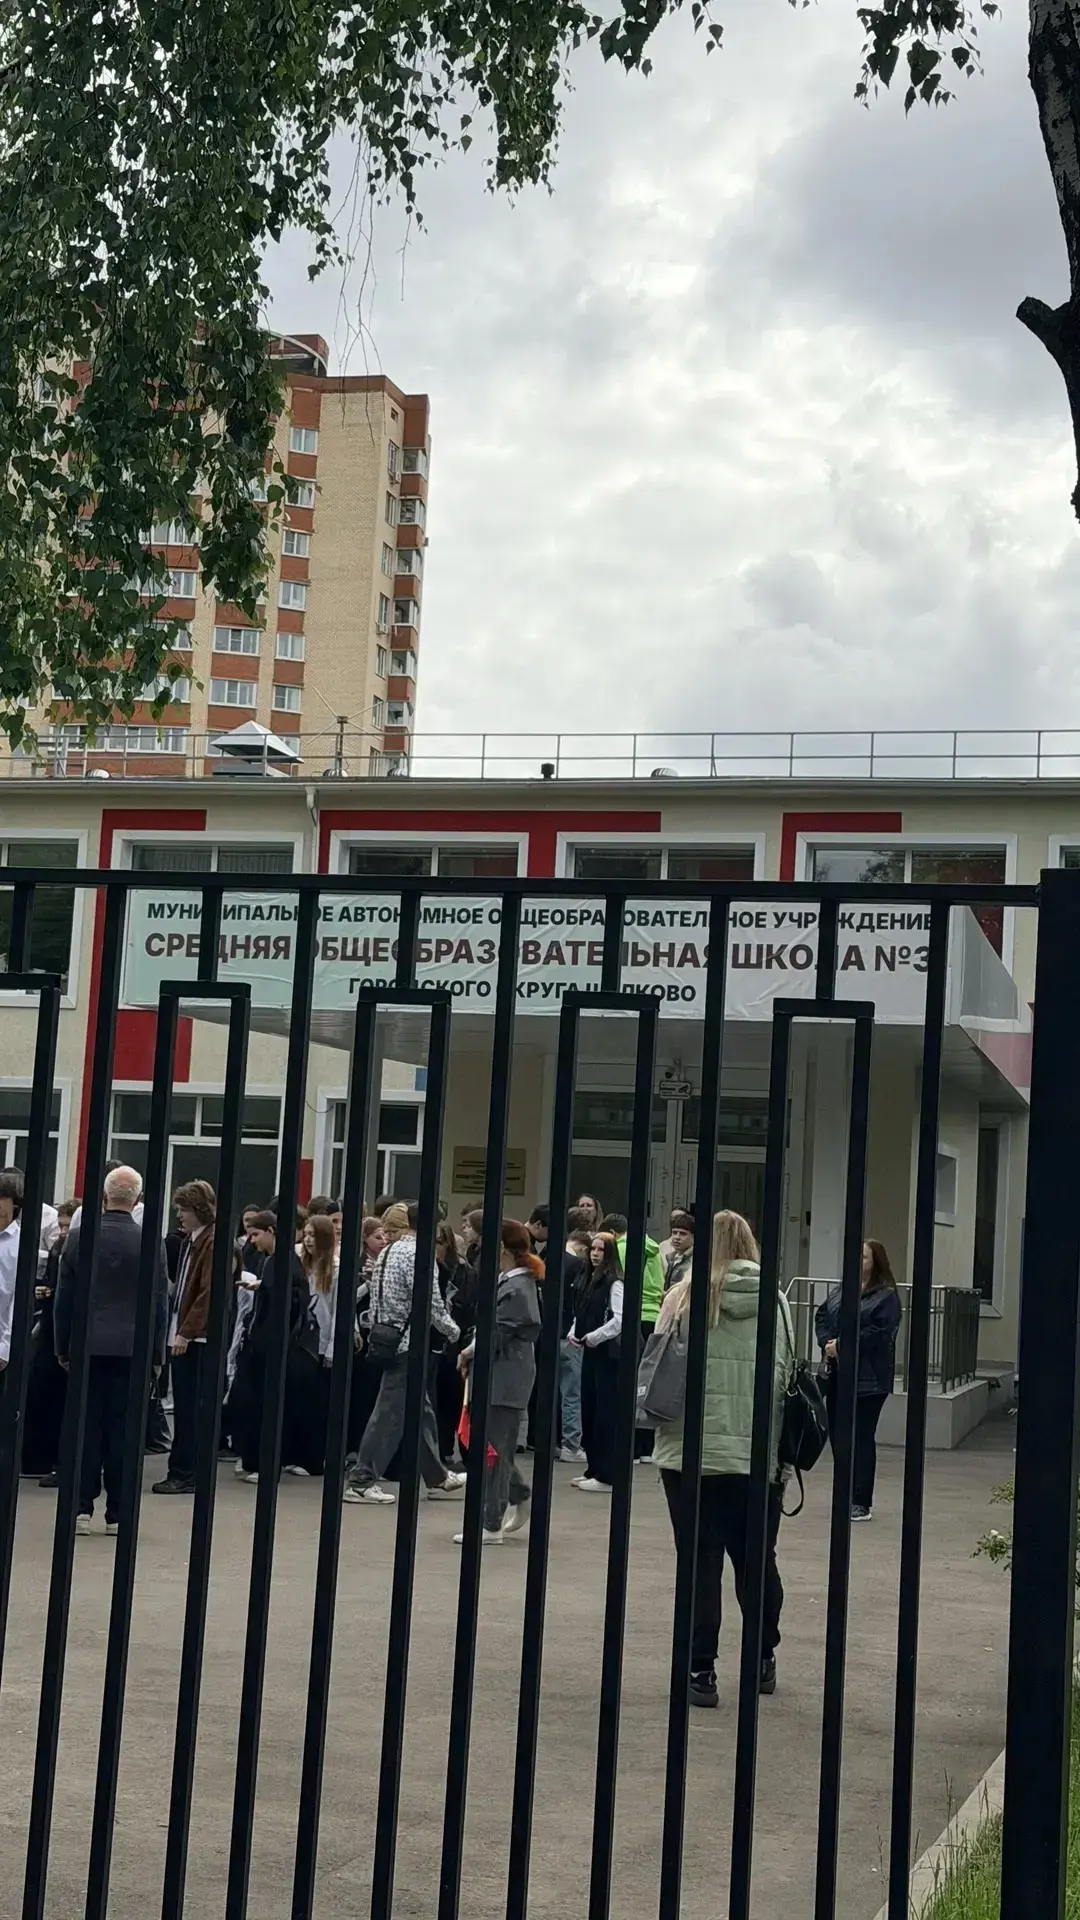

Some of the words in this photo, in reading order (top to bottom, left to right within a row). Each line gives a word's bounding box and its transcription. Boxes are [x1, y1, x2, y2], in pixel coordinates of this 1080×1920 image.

[147, 902, 334, 923] МУНИИПАЛЬЕ
[338, 906, 484, 925] АВТОНМНОЕ
[488, 908, 766, 929] ОЩЕОБРАОВАТЕЛНОЕ
[773, 911, 931, 933] УЧРЖДЕНИЕ
[314, 936, 709, 968] БЩЕБРАЗВАТЕЬНА
[731, 943, 866, 971] ШКОА
[349, 977, 492, 998] ГОРСКОГО
[515, 981, 579, 1000] КРУГА
[585, 982, 696, 1002] ЛКОВО
